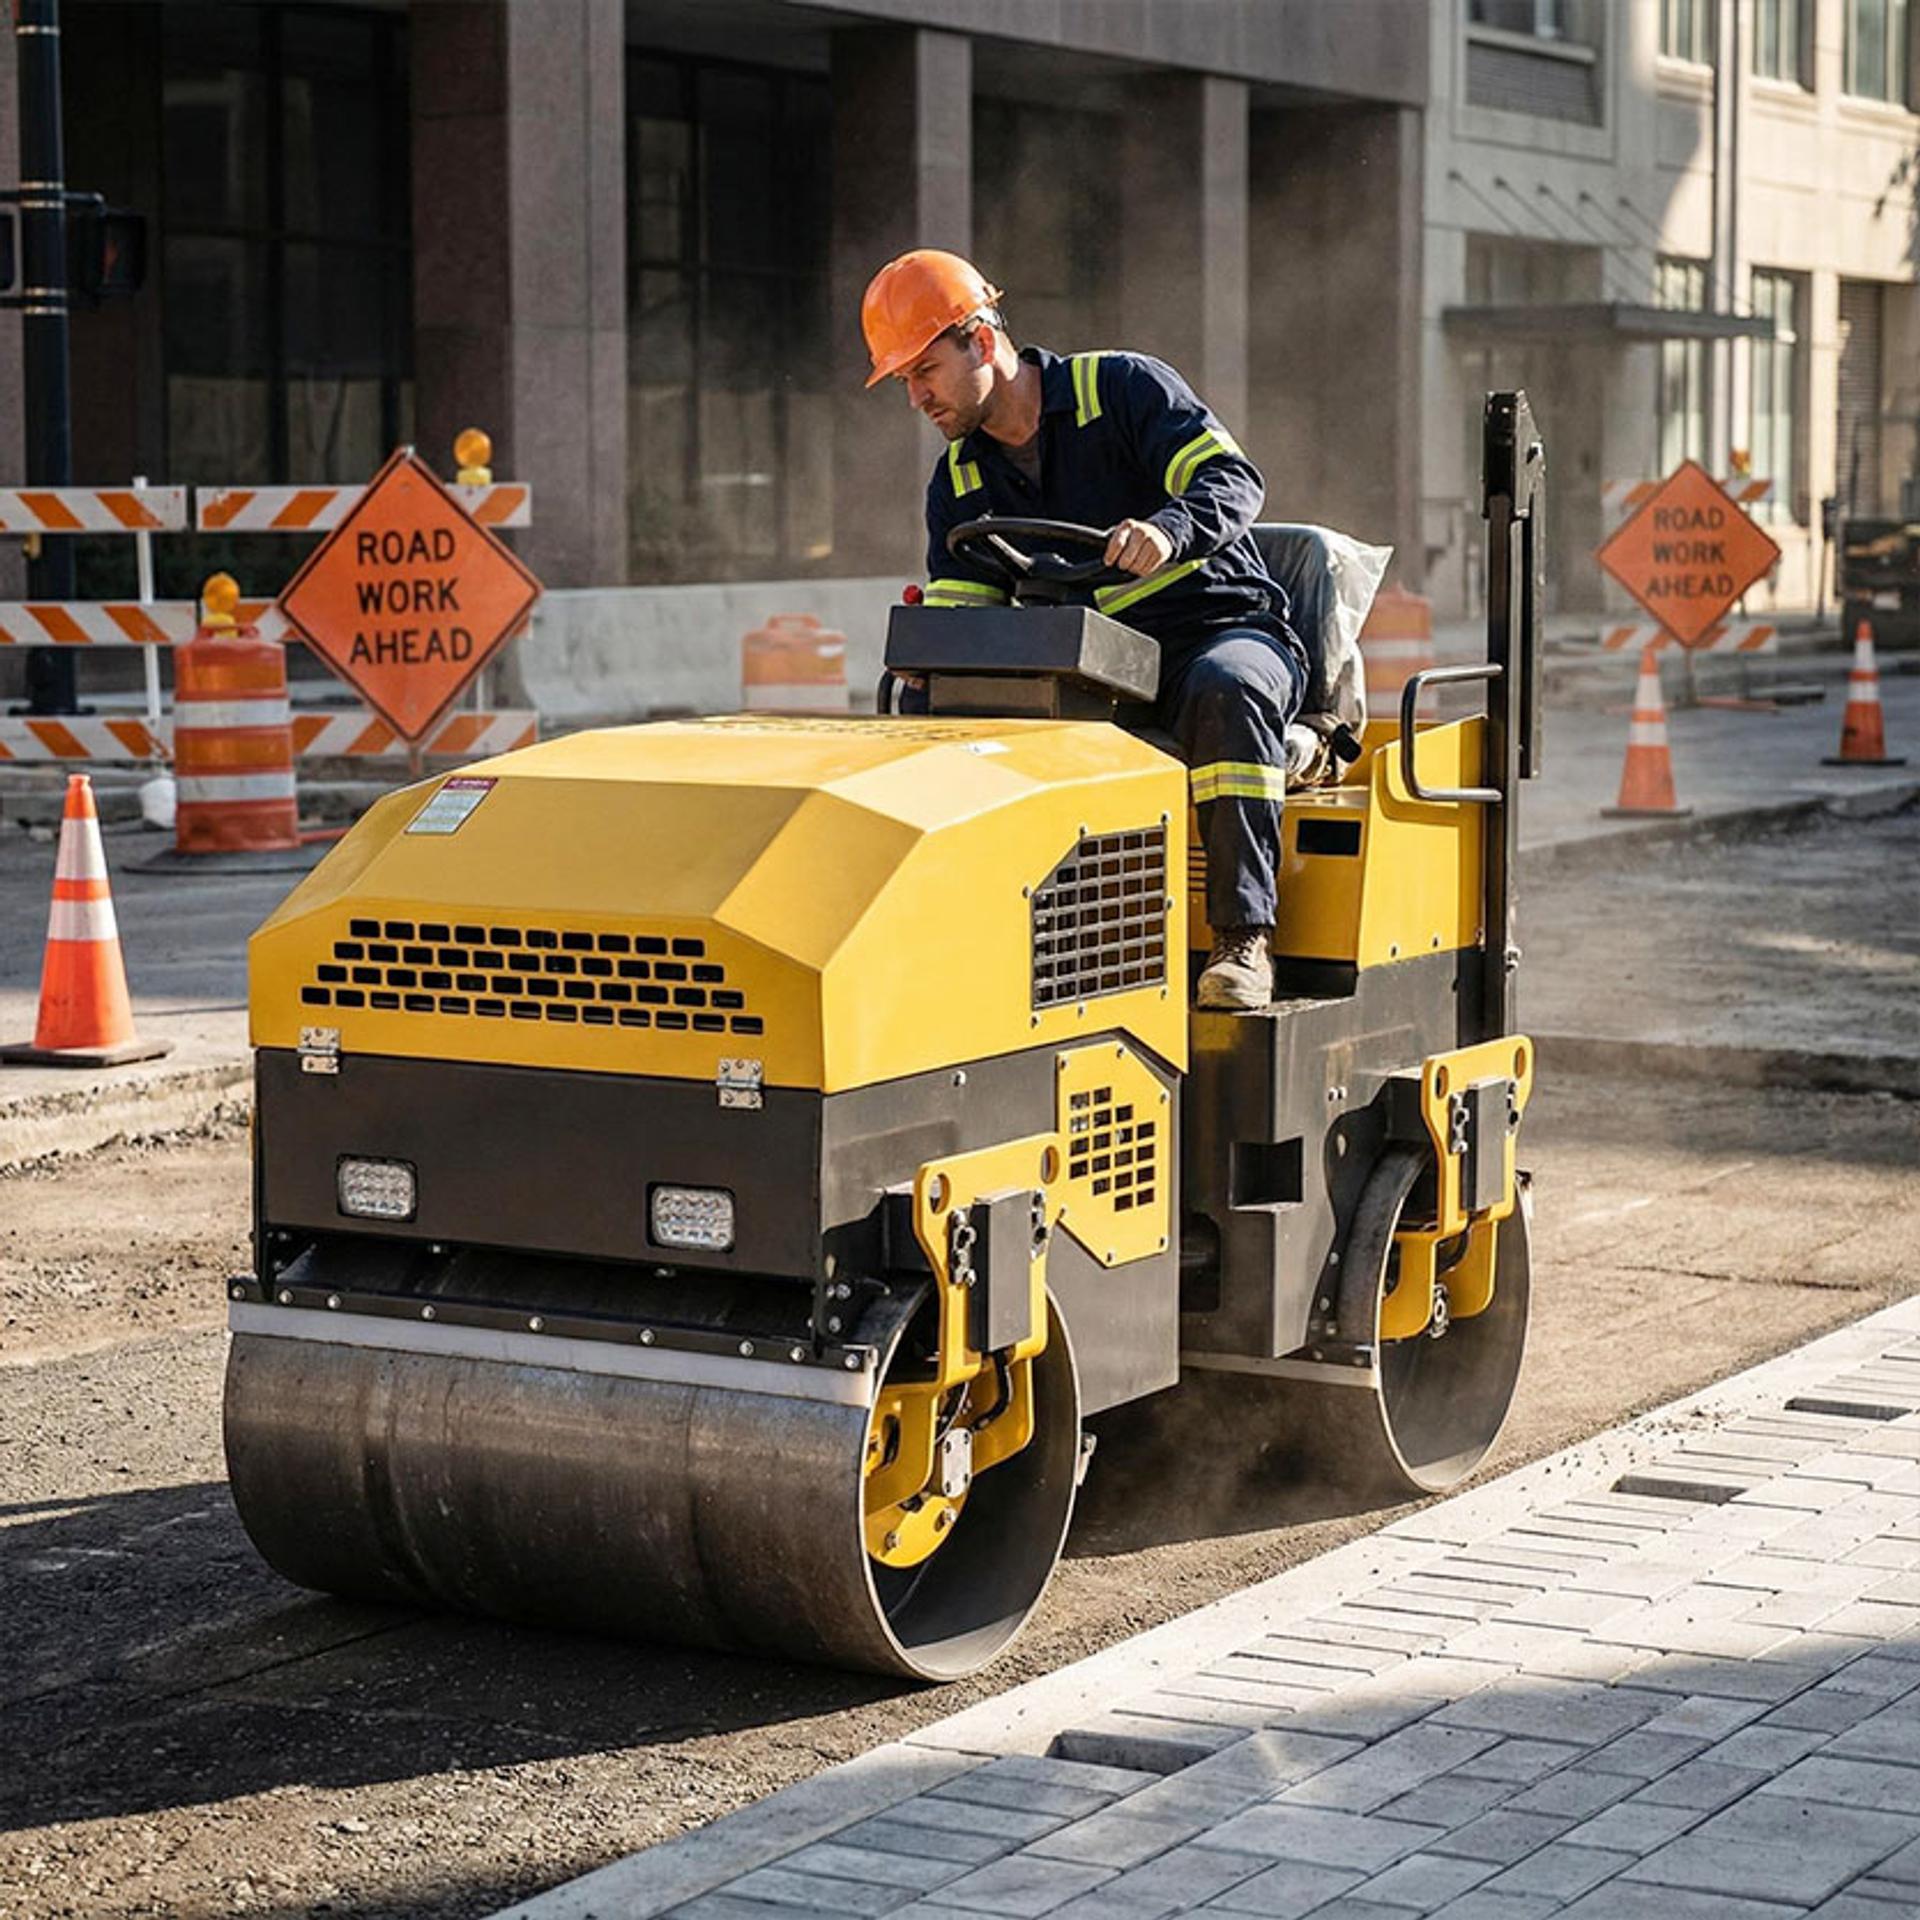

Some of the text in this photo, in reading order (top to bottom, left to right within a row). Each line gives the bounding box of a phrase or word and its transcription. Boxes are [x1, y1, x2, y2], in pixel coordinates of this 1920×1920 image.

[1653, 506, 1725, 531] ROAD
[357, 528, 456, 566] ROAD
[1653, 541, 1726, 565] WORK
[356, 577, 460, 615] WORK
[1646, 574, 1734, 598] AHEAD
[350, 627, 473, 665] AHEAD
